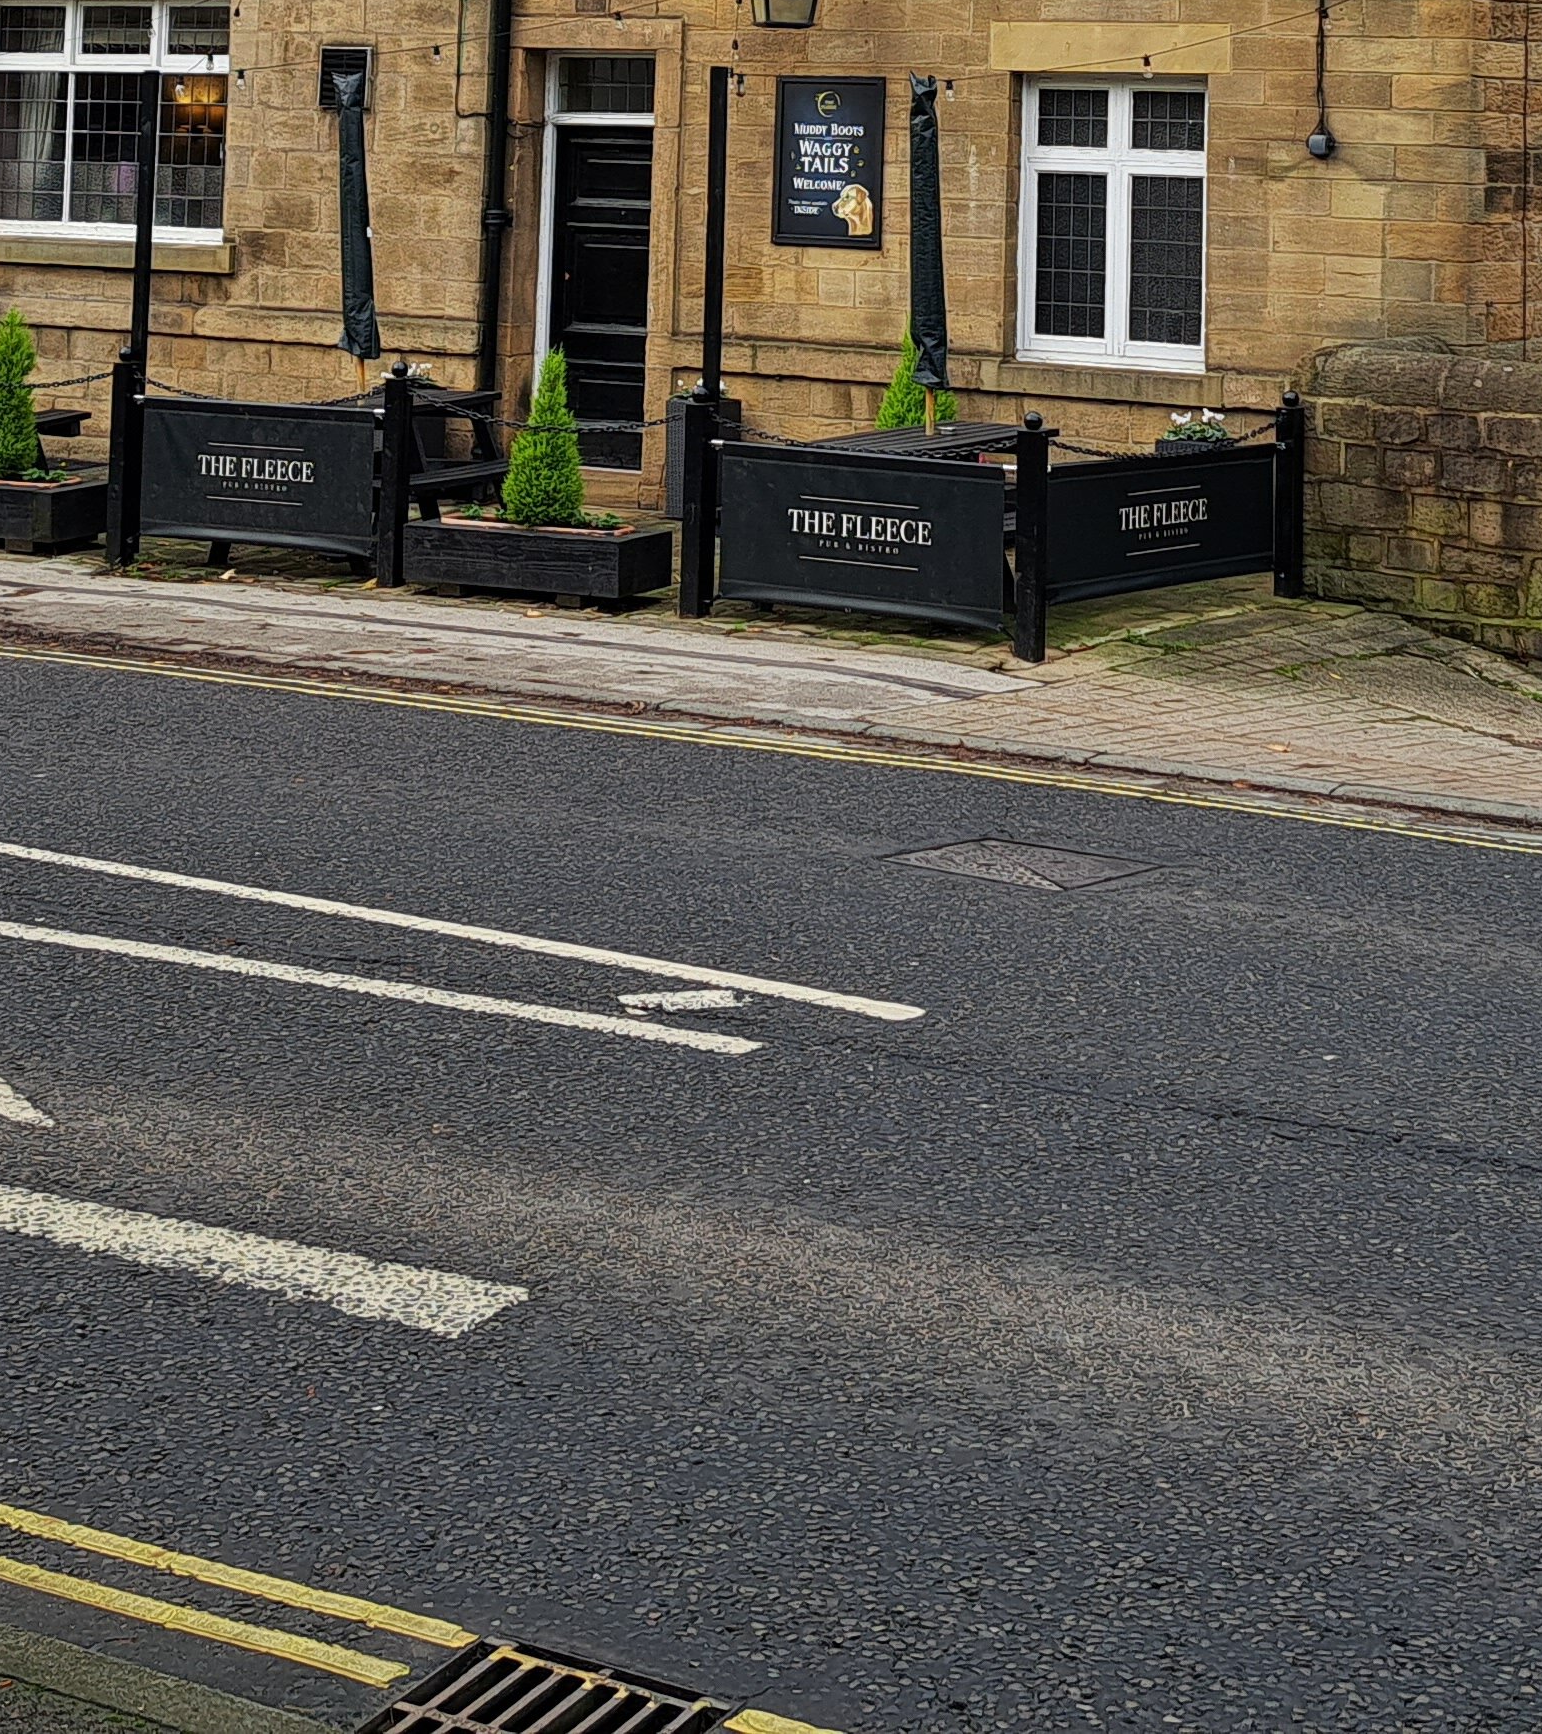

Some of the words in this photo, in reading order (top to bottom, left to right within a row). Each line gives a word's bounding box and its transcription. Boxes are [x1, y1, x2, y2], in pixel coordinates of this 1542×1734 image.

[799, 139, 852, 157] WAGGY
[800, 156, 850, 173] TAILS
[198, 454, 237, 477] THE
[241, 457, 315, 483] FLEECE
[787, 508, 836, 536] THE
[841, 513, 932, 546] FLEECE
[1119, 505, 1150, 531] THE
[1153, 498, 1208, 526] FLEECE
